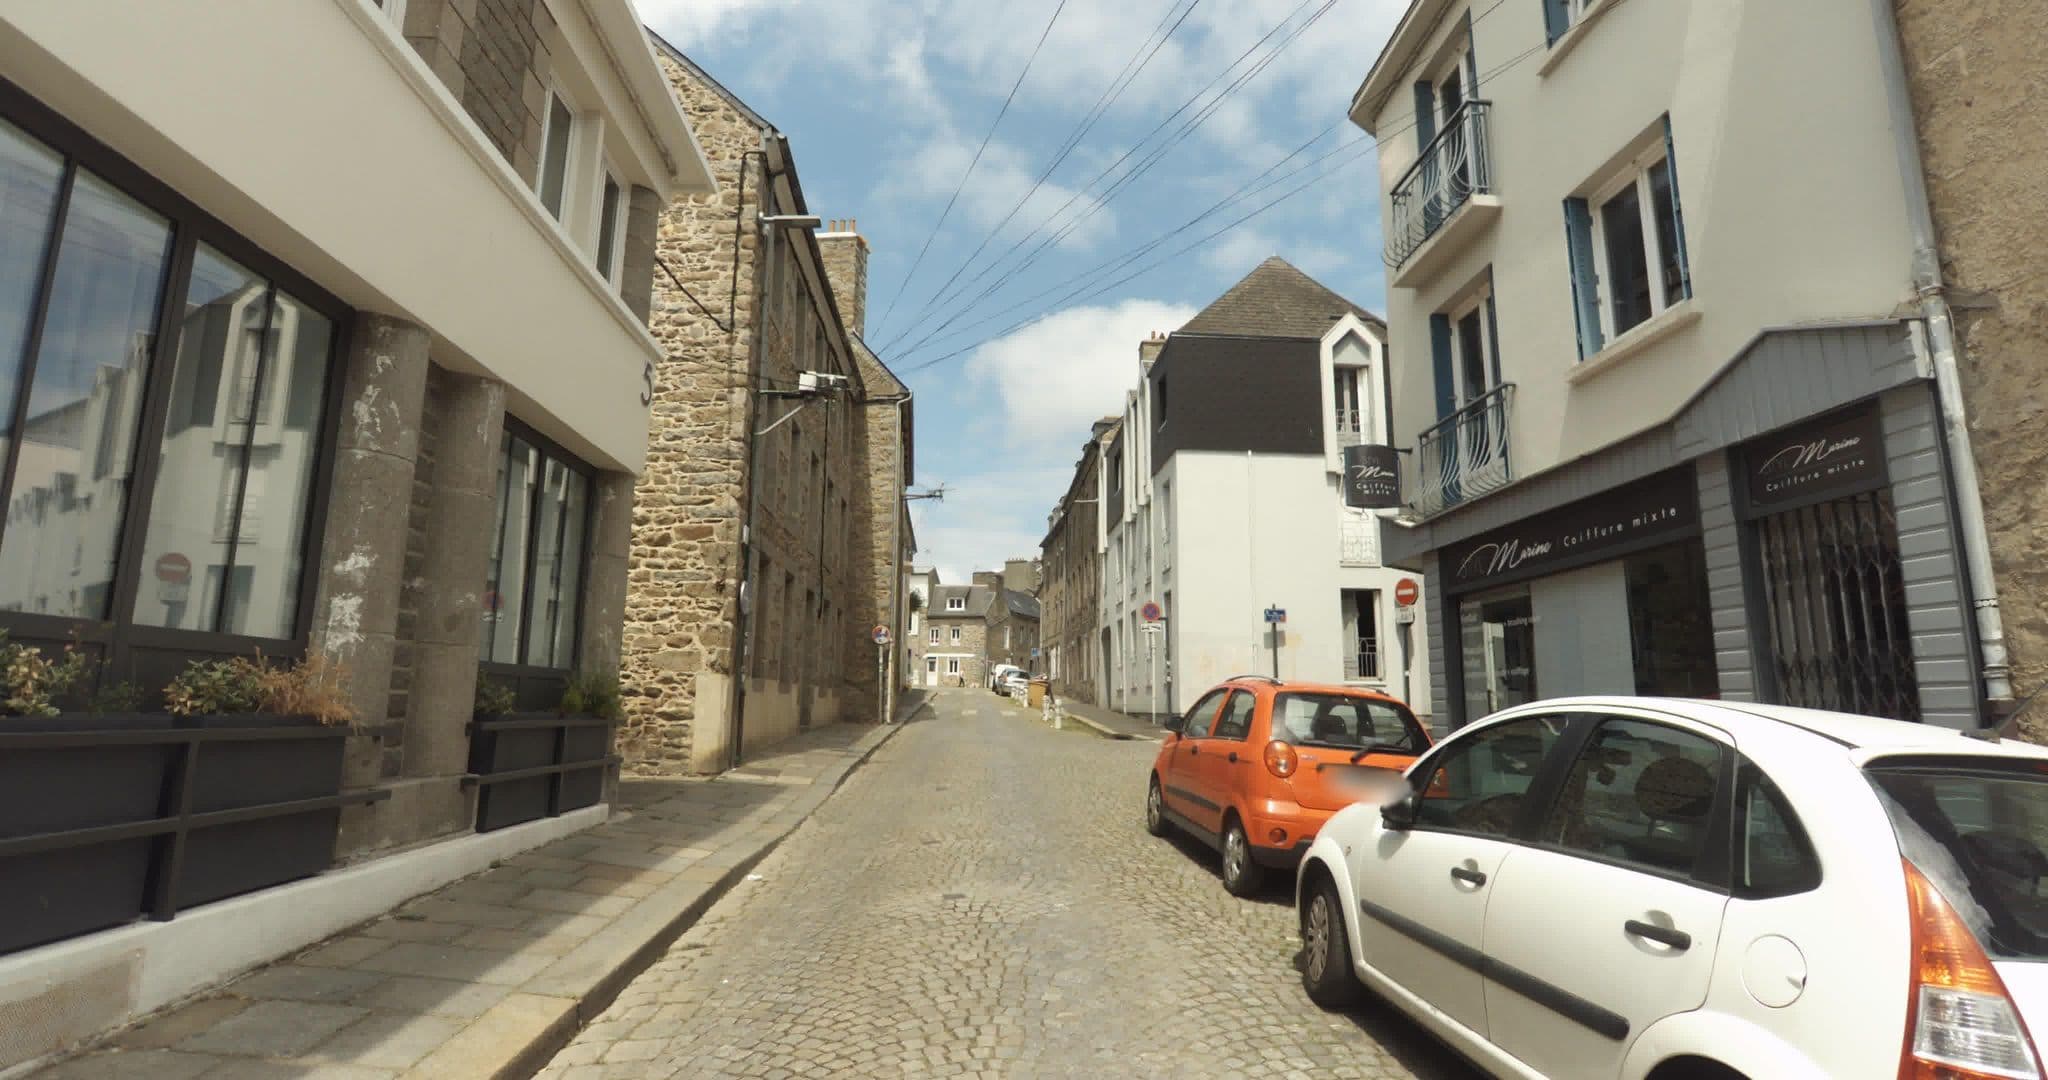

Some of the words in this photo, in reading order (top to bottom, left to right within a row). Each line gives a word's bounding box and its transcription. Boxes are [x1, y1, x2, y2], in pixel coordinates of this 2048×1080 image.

[1766, 471, 1820, 492] Coiffure
[1827, 459, 1865, 475] mixte
[1456, 538, 1552, 576] Marine
[1563, 522, 1623, 547] Coiffure
[1632, 507, 1677, 527] mixte
